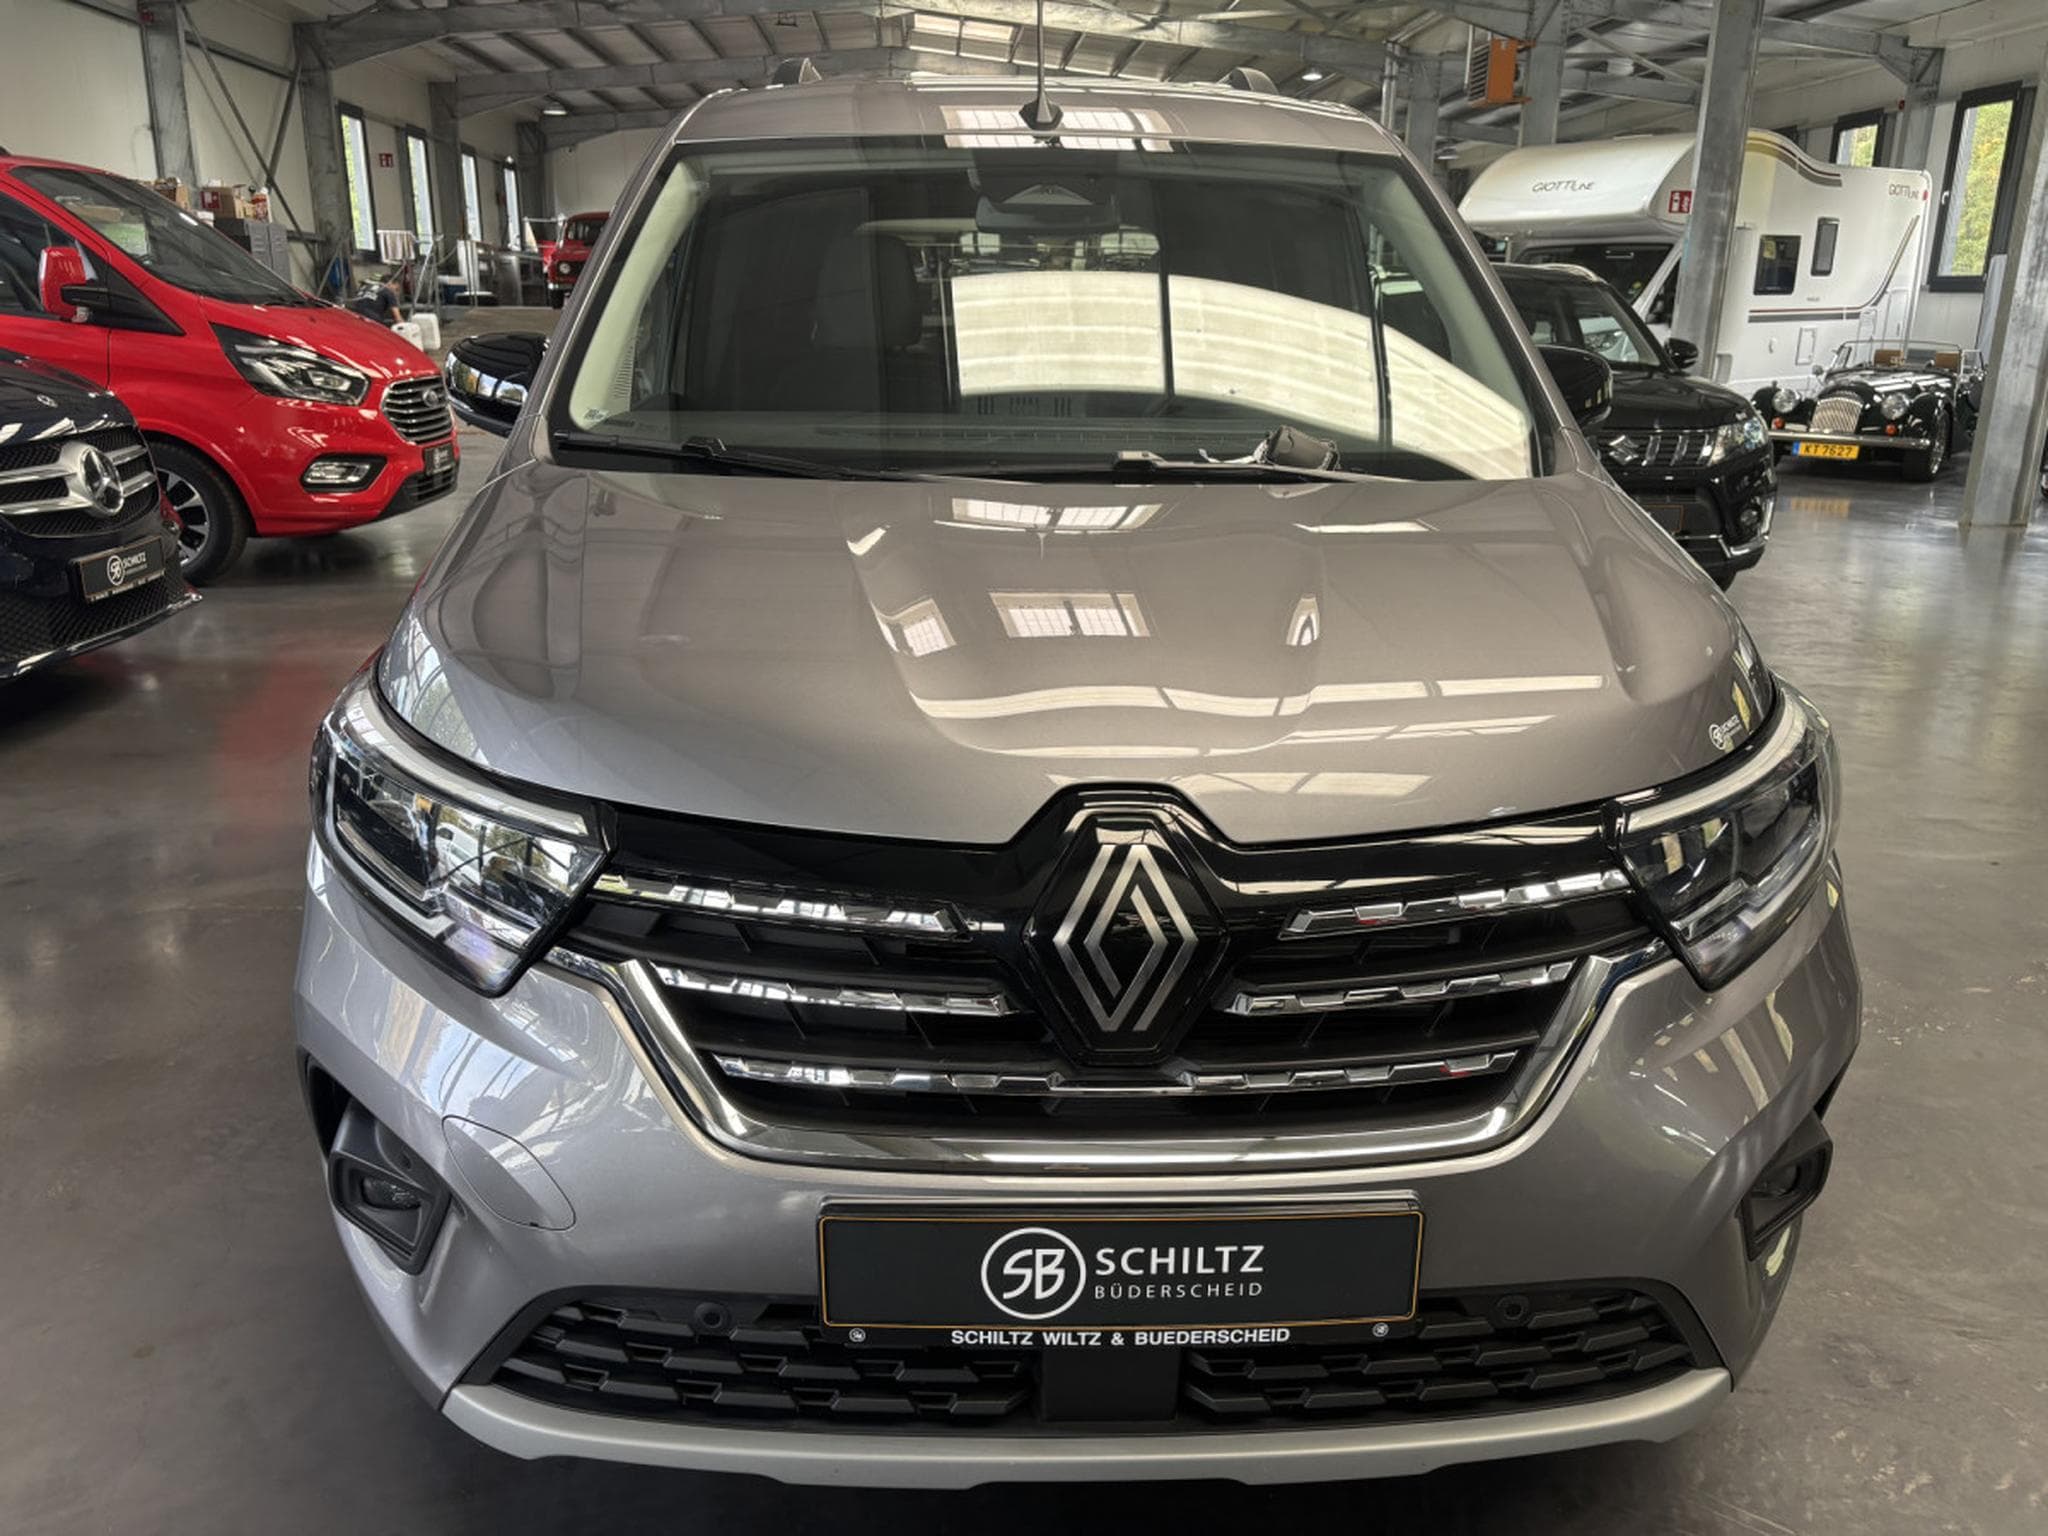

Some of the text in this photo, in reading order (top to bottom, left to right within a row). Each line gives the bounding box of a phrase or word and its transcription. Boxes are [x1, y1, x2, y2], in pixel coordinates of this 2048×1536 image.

[1095, 1245, 1264, 1276] SCHILTZ
[1002, 1248, 1066, 1300] SB
[1095, 1281, 1263, 1300] BÜDERSCHEID
[951, 1328, 1290, 1346] SCHILTZ WILTZ & BUEDERSCHEID
